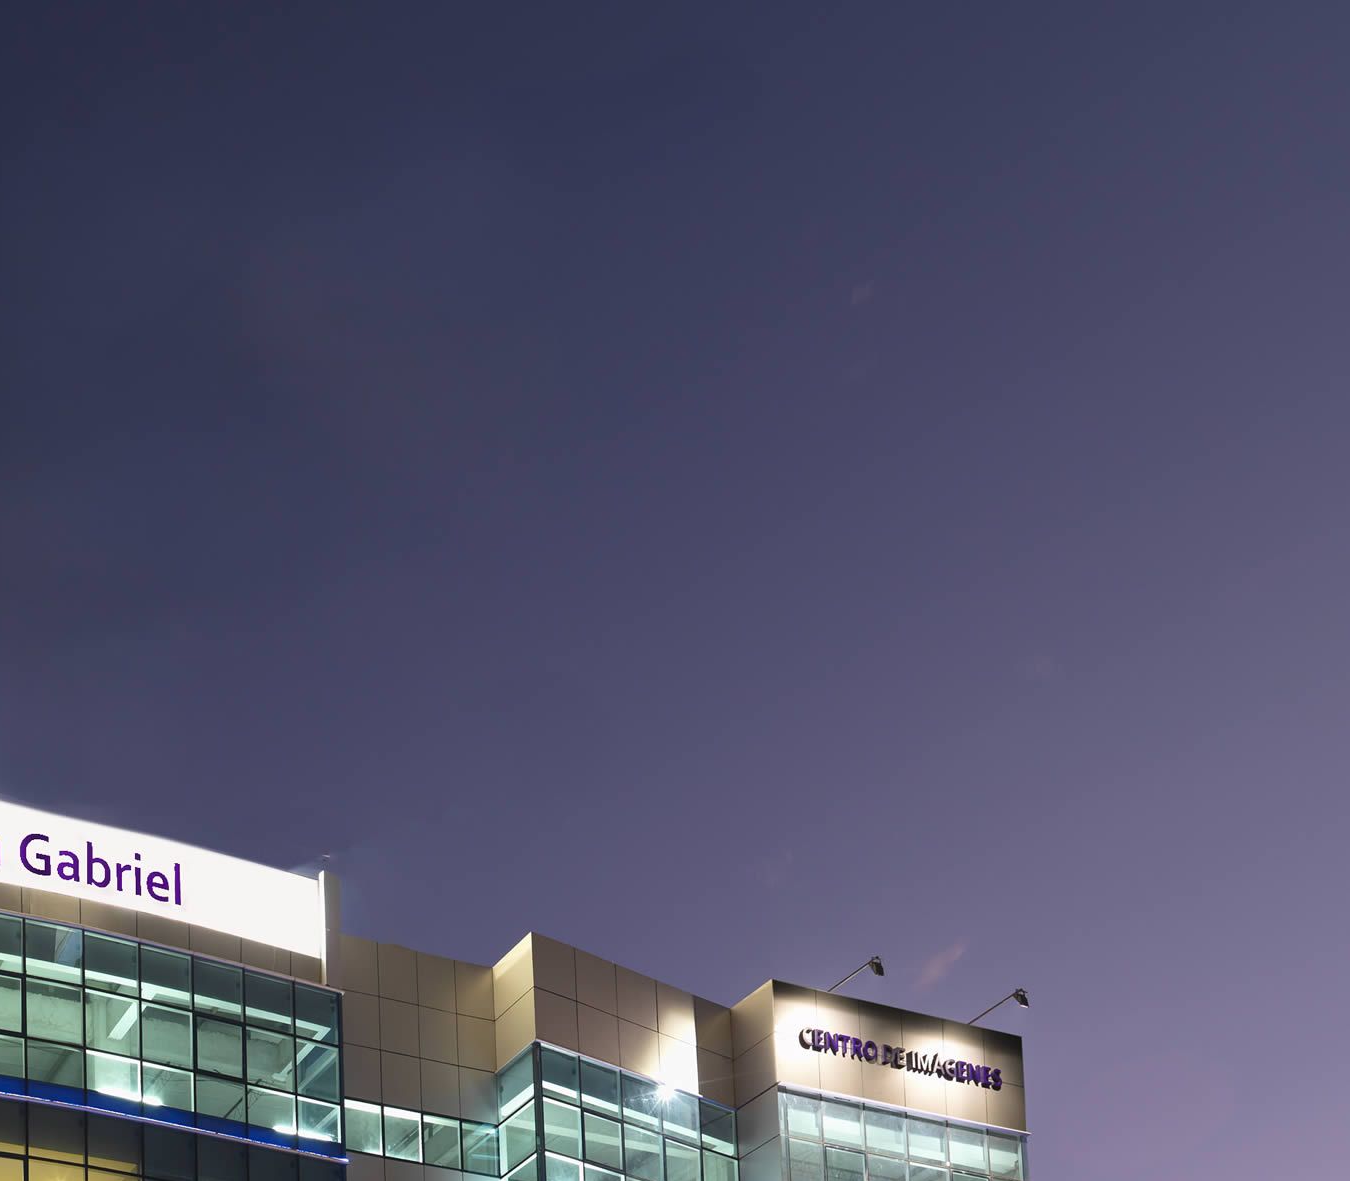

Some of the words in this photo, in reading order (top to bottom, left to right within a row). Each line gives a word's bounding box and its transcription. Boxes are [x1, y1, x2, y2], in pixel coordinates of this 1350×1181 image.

[19, 833, 182, 906] Gabriel
[799, 1026, 877, 1062] CENTRO
[881, 1043, 906, 1070] DE
[906, 1050, 1003, 1091] IMAGENES
